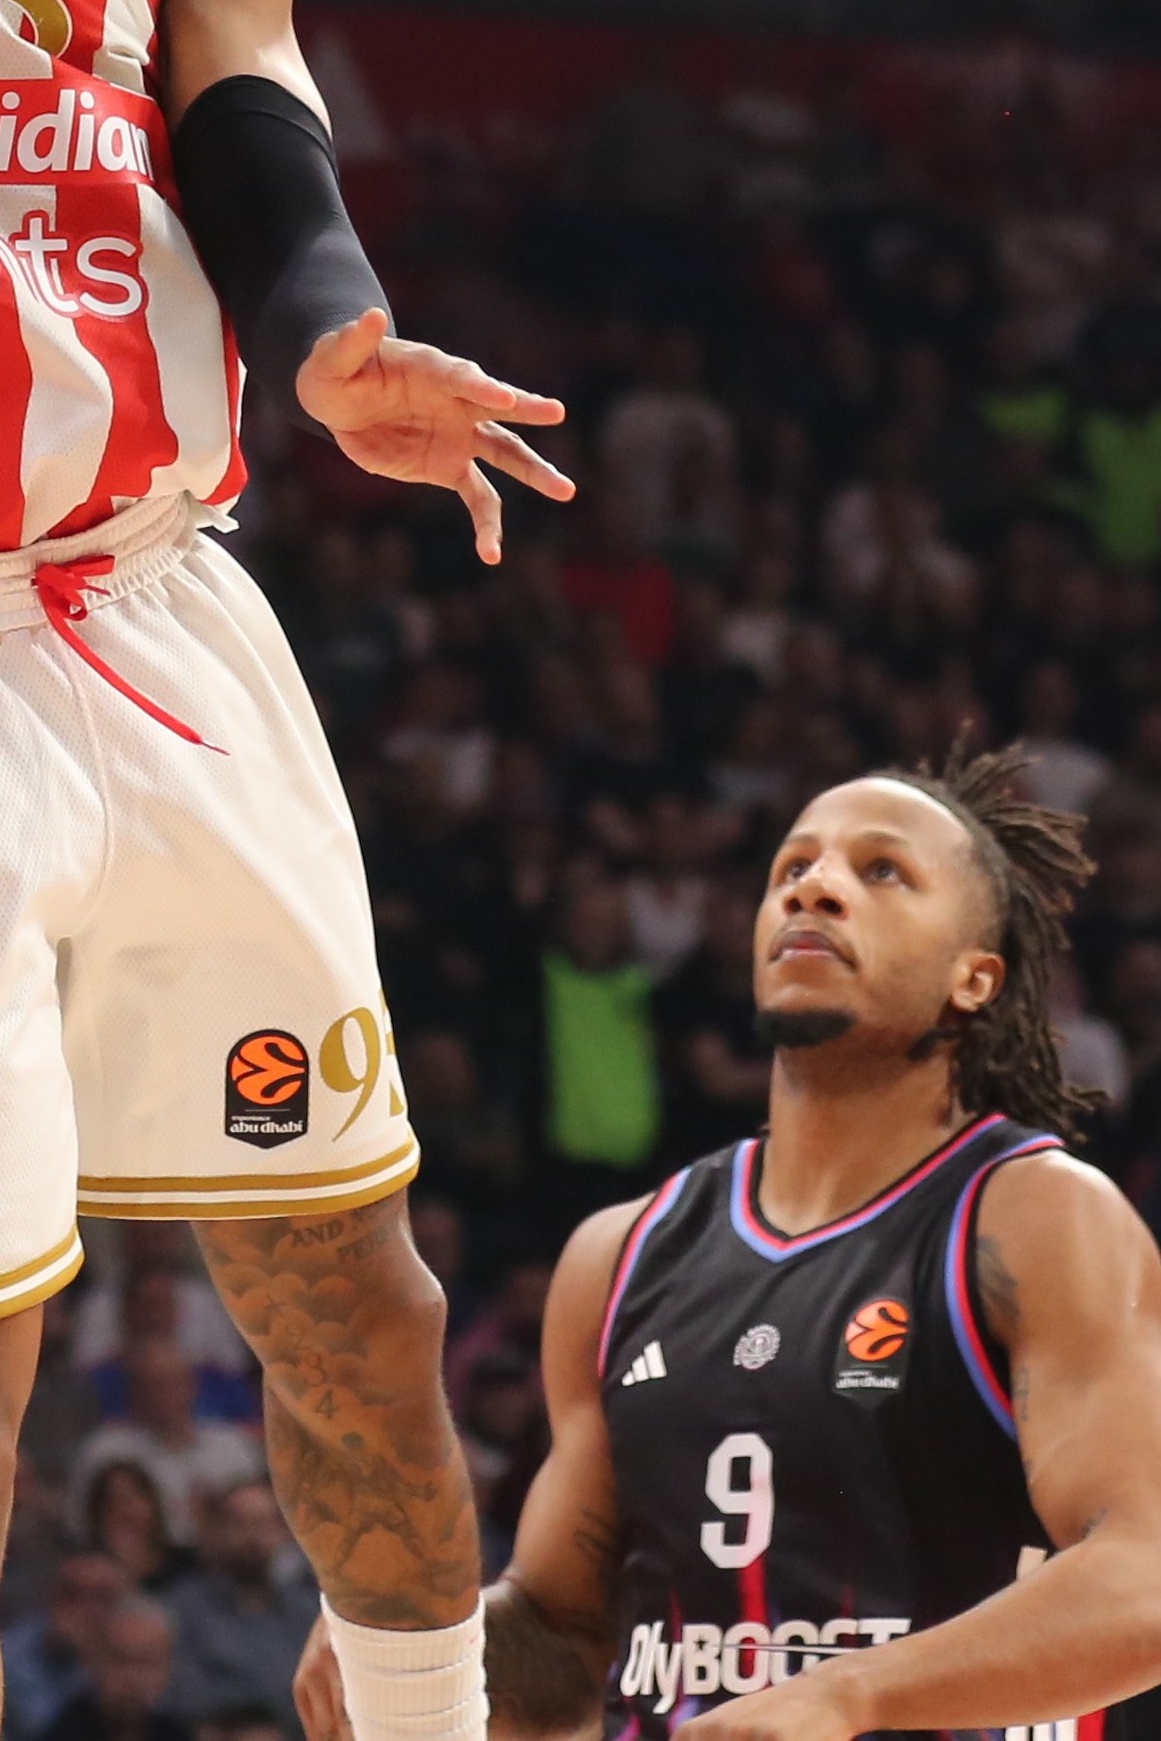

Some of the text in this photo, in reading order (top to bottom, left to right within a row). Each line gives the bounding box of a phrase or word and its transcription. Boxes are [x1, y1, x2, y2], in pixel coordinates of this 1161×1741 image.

[229, 1119, 304, 1134] abu dhabi
[700, 1432, 775, 1569] 9
